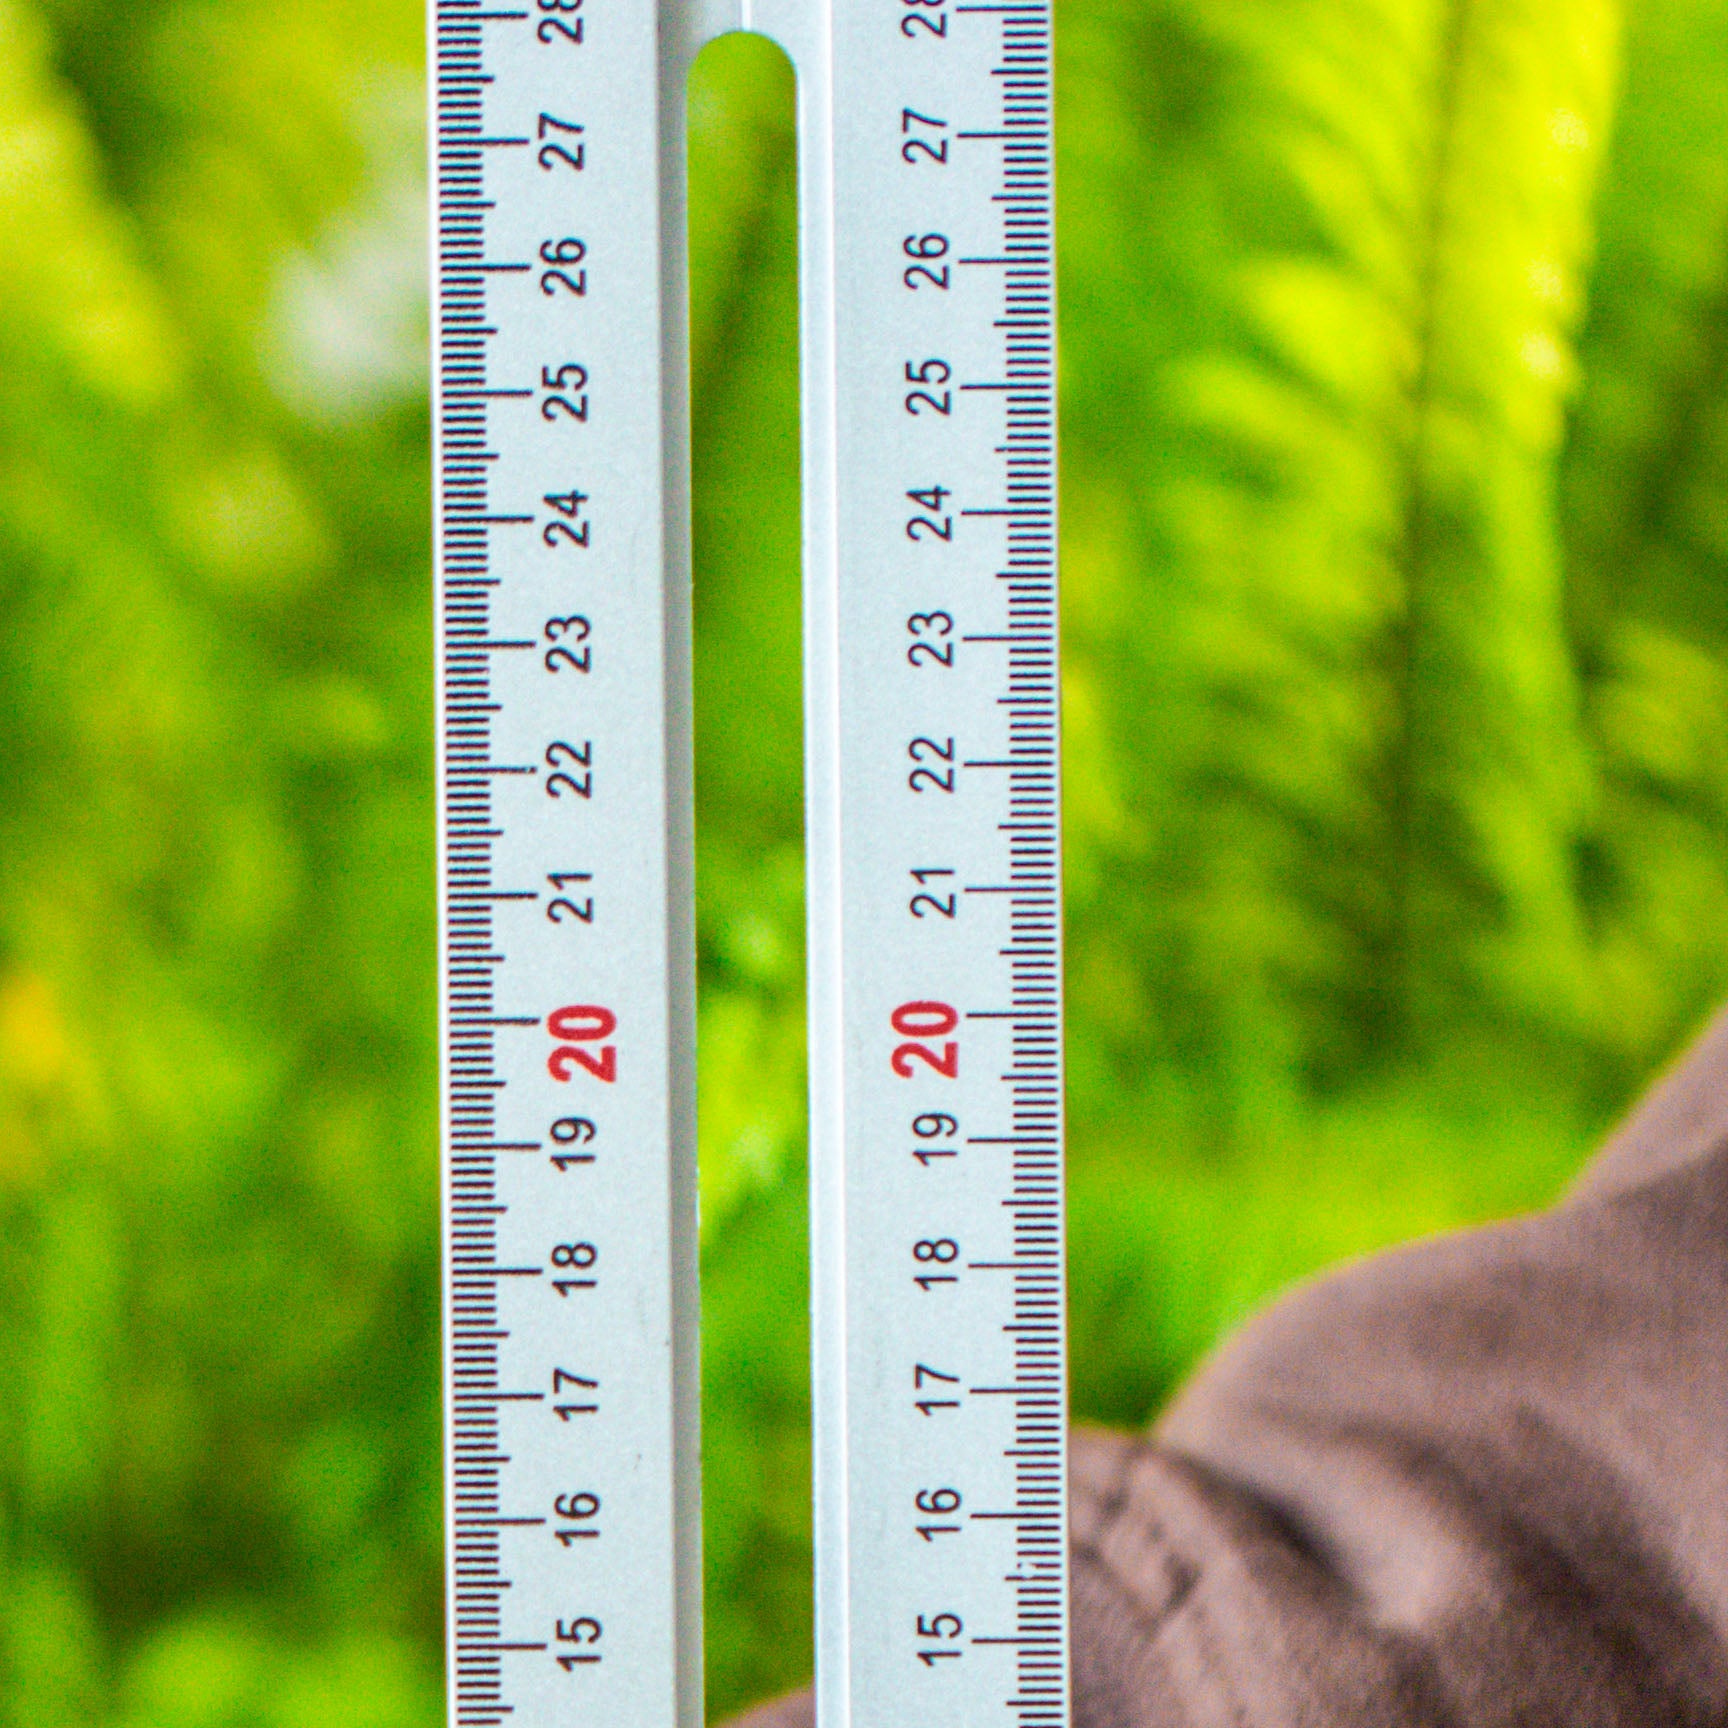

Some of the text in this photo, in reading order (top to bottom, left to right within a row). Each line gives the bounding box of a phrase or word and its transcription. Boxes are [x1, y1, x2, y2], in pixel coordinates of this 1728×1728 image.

[537, 113, 584, 172] 27
[901, 108, 948, 165] 27
[539, 238, 586, 297] 26
[902, 234, 949, 290] 26
[541, 364, 588, 423] 25
[904, 359, 951, 416] 25
[542, 490, 589, 549] 24
[905, 485, 952, 542] 24
[544, 615, 591, 674] 23
[907, 611, 954, 668] 23
[545, 741, 592, 799] 22
[908, 737, 955, 794] 22
[546, 873, 593, 924] 21
[909, 869, 956, 919] 21
[547, 1004, 617, 1083] 20
[891, 1000, 959, 1079] 20
[549, 1117, 596, 1172] 19
[912, 1113, 958, 1167] 19
[550, 1242, 597, 1298] 18
[912, 1238, 959, 1292] 18
[552, 1368, 599, 1422] 17
[914, 1364, 960, 1416] 17
[554, 1492, 600, 1547] 16
[915, 1488, 961, 1542] 16
[556, 1617, 602, 1672] 15
[916, 1613, 963, 1667] 15
